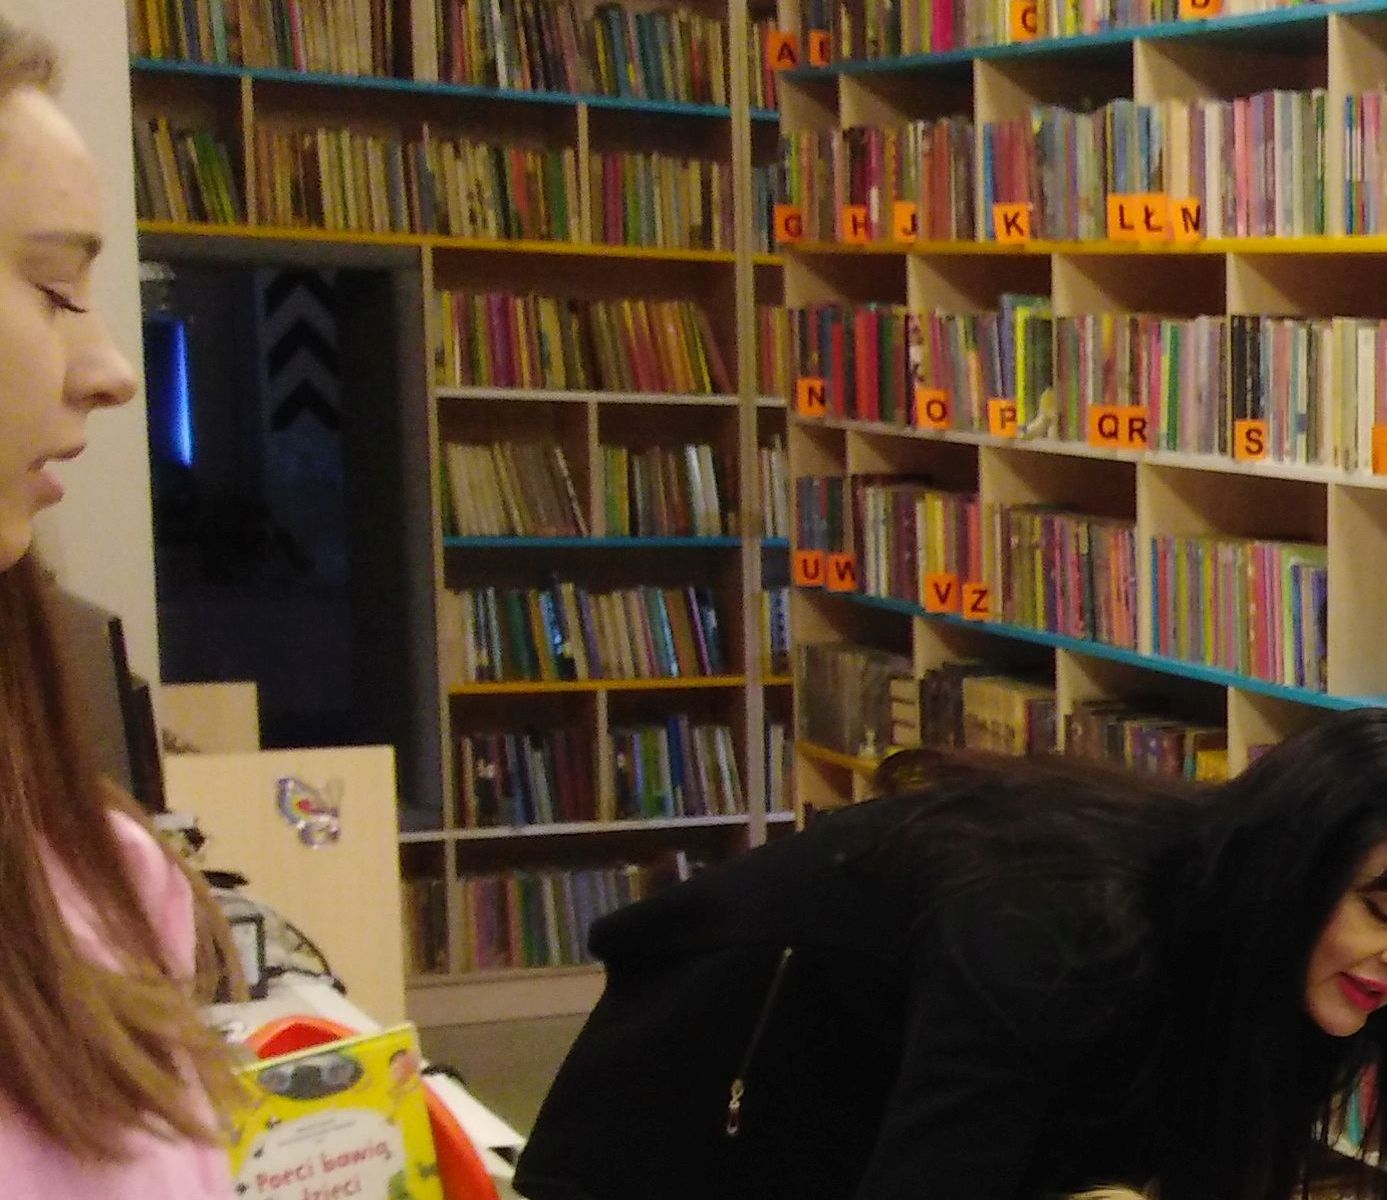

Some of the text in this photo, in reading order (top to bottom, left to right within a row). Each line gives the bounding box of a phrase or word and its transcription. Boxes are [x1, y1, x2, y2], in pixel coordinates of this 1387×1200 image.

[777, 42, 797, 64] A
[901, 213, 917, 235] J
[1003, 210, 1024, 236] K
[1119, 204, 1134, 230] L
[1144, 205, 1163, 232] Ł
[808, 386, 825, 408] N
[926, 400, 947, 422] O
[1000, 405, 1017, 429] P
[1097, 414, 1118, 439] Q
[1128, 418, 1147, 442] R
[1245, 428, 1263, 456] S
[803, 559, 819, 580] U
[933, 582, 951, 604] V
[971, 589, 988, 613] Z
